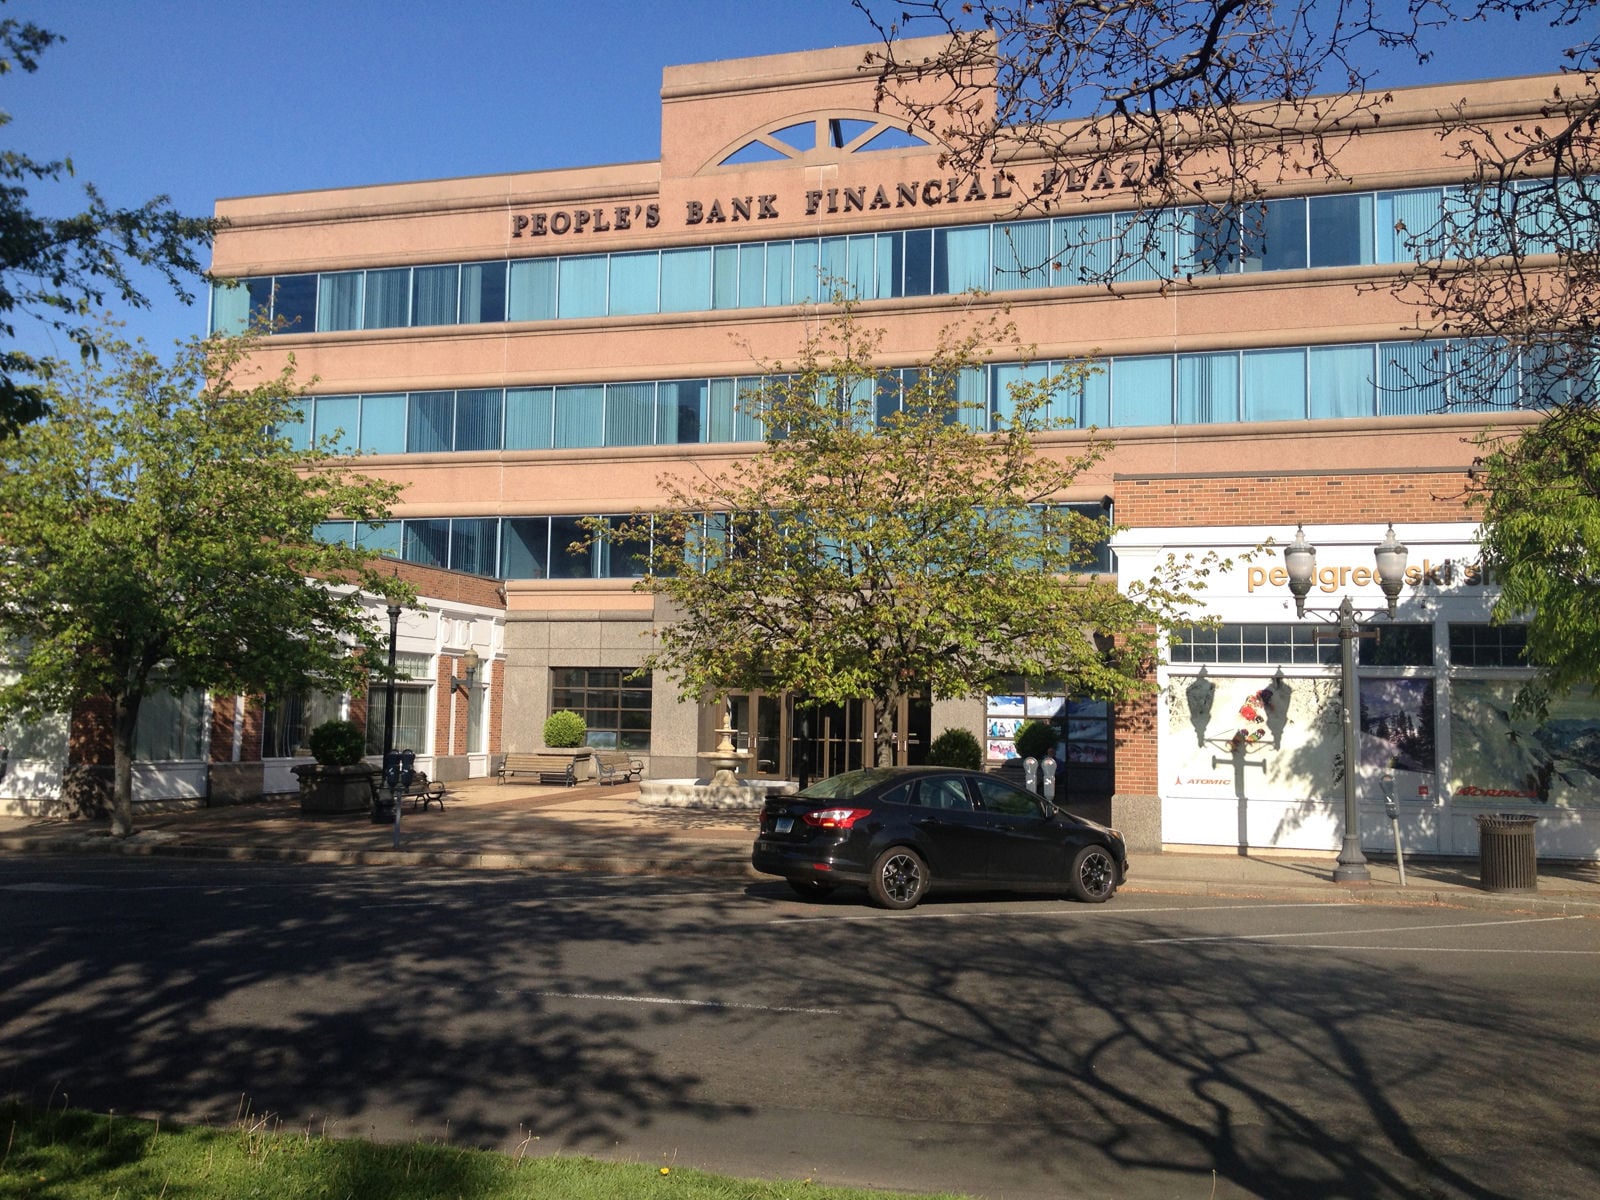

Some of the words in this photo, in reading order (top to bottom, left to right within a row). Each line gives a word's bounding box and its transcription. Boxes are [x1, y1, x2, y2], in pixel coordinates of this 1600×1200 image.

[512, 203, 660, 238] PEOPLE'S
[686, 194, 778, 225] BANK
[805, 174, 1012, 215] FINANCIAL
[1041, 160, 1168, 195] PLAZ
[1247, 562, 1391, 593] peigre
[1405, 559, 1451, 586] ski
